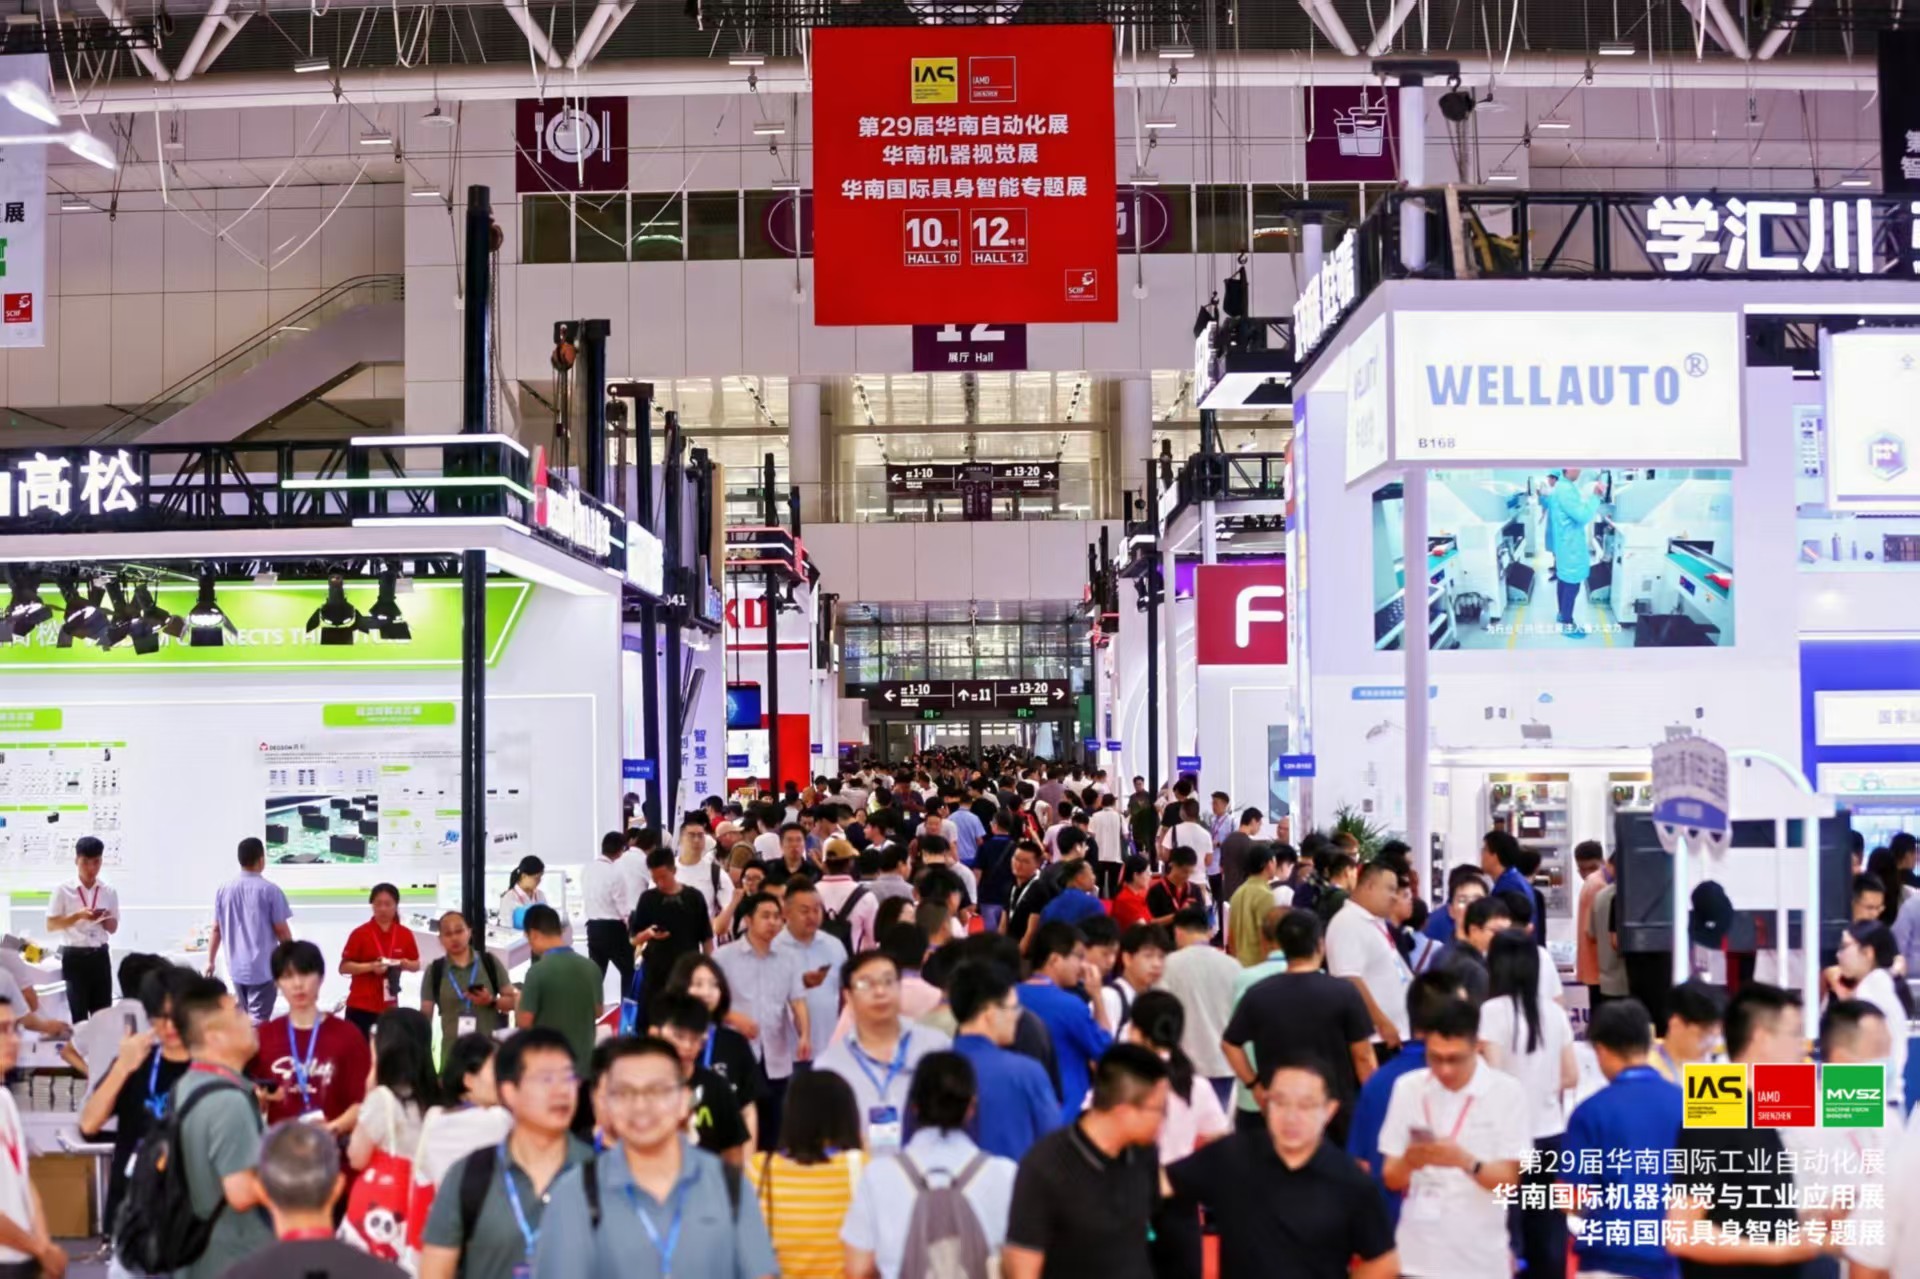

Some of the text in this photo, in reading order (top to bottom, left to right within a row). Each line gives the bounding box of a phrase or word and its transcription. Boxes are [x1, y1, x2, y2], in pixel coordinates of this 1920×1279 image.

[914, 66, 955, 82] IAS
[858, 114, 1069, 138] 第29届华南自动化展
[882, 143, 1039, 166] 华南机器视觉展
[841, 176, 1087, 200] 华南国际具身智能专题展
[1646, 195, 1874, 274] 学汇川
[907, 253, 957, 264] HALL 10
[975, 253, 1024, 263] HALL 12
[948, 352, 993, 363] 展厅 Hall
[1418, 438, 1456, 449] B168
[17, 449, 142, 517] 高松
[909, 684, 930, 695] 1-10
[979, 688, 991, 701] 11
[1019, 682, 1048, 694] 13-20
[693, 729, 708, 795] 智慧互联
